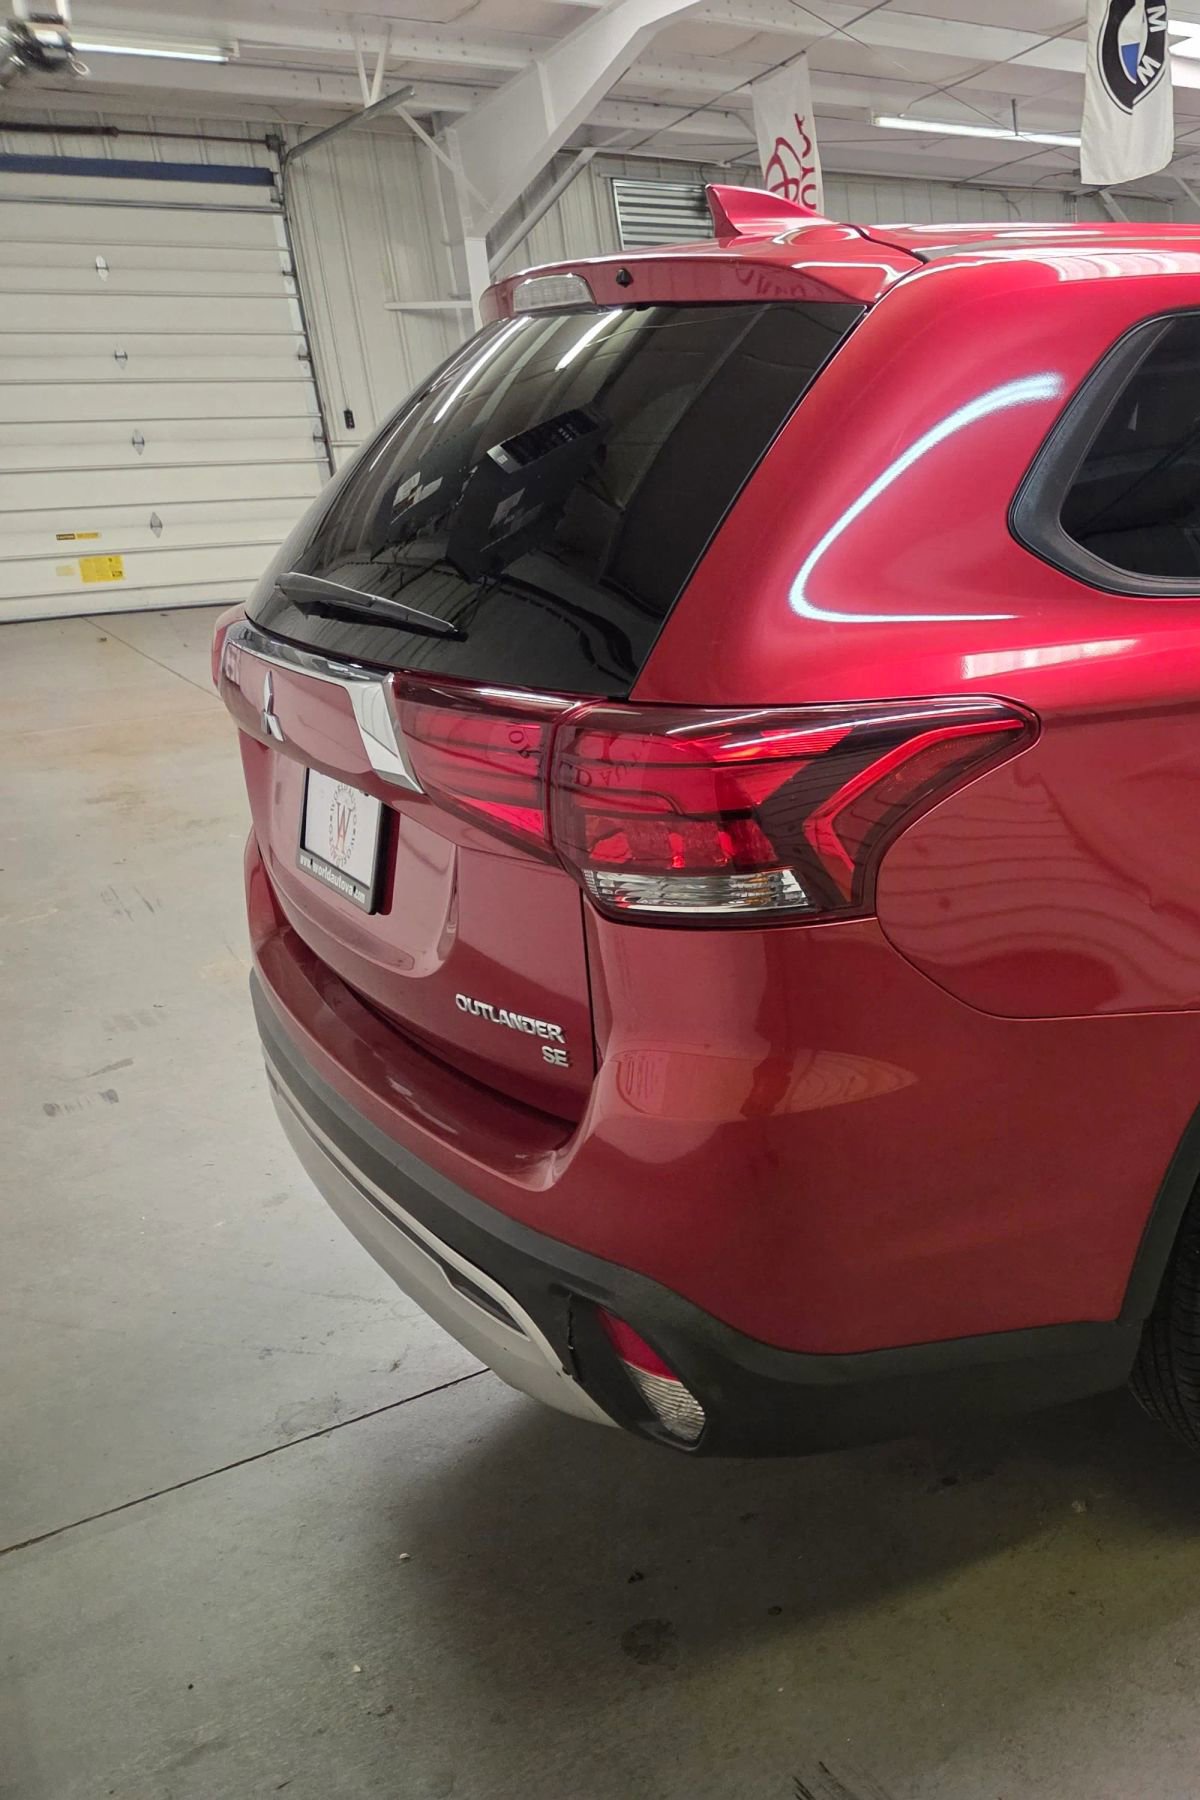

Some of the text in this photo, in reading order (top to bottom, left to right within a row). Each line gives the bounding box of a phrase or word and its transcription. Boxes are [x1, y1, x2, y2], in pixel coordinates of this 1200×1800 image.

[1136, 4, 1168, 87] MW
[455, 993, 566, 1044] OUTLANDER
[541, 1045, 569, 1068] SE
